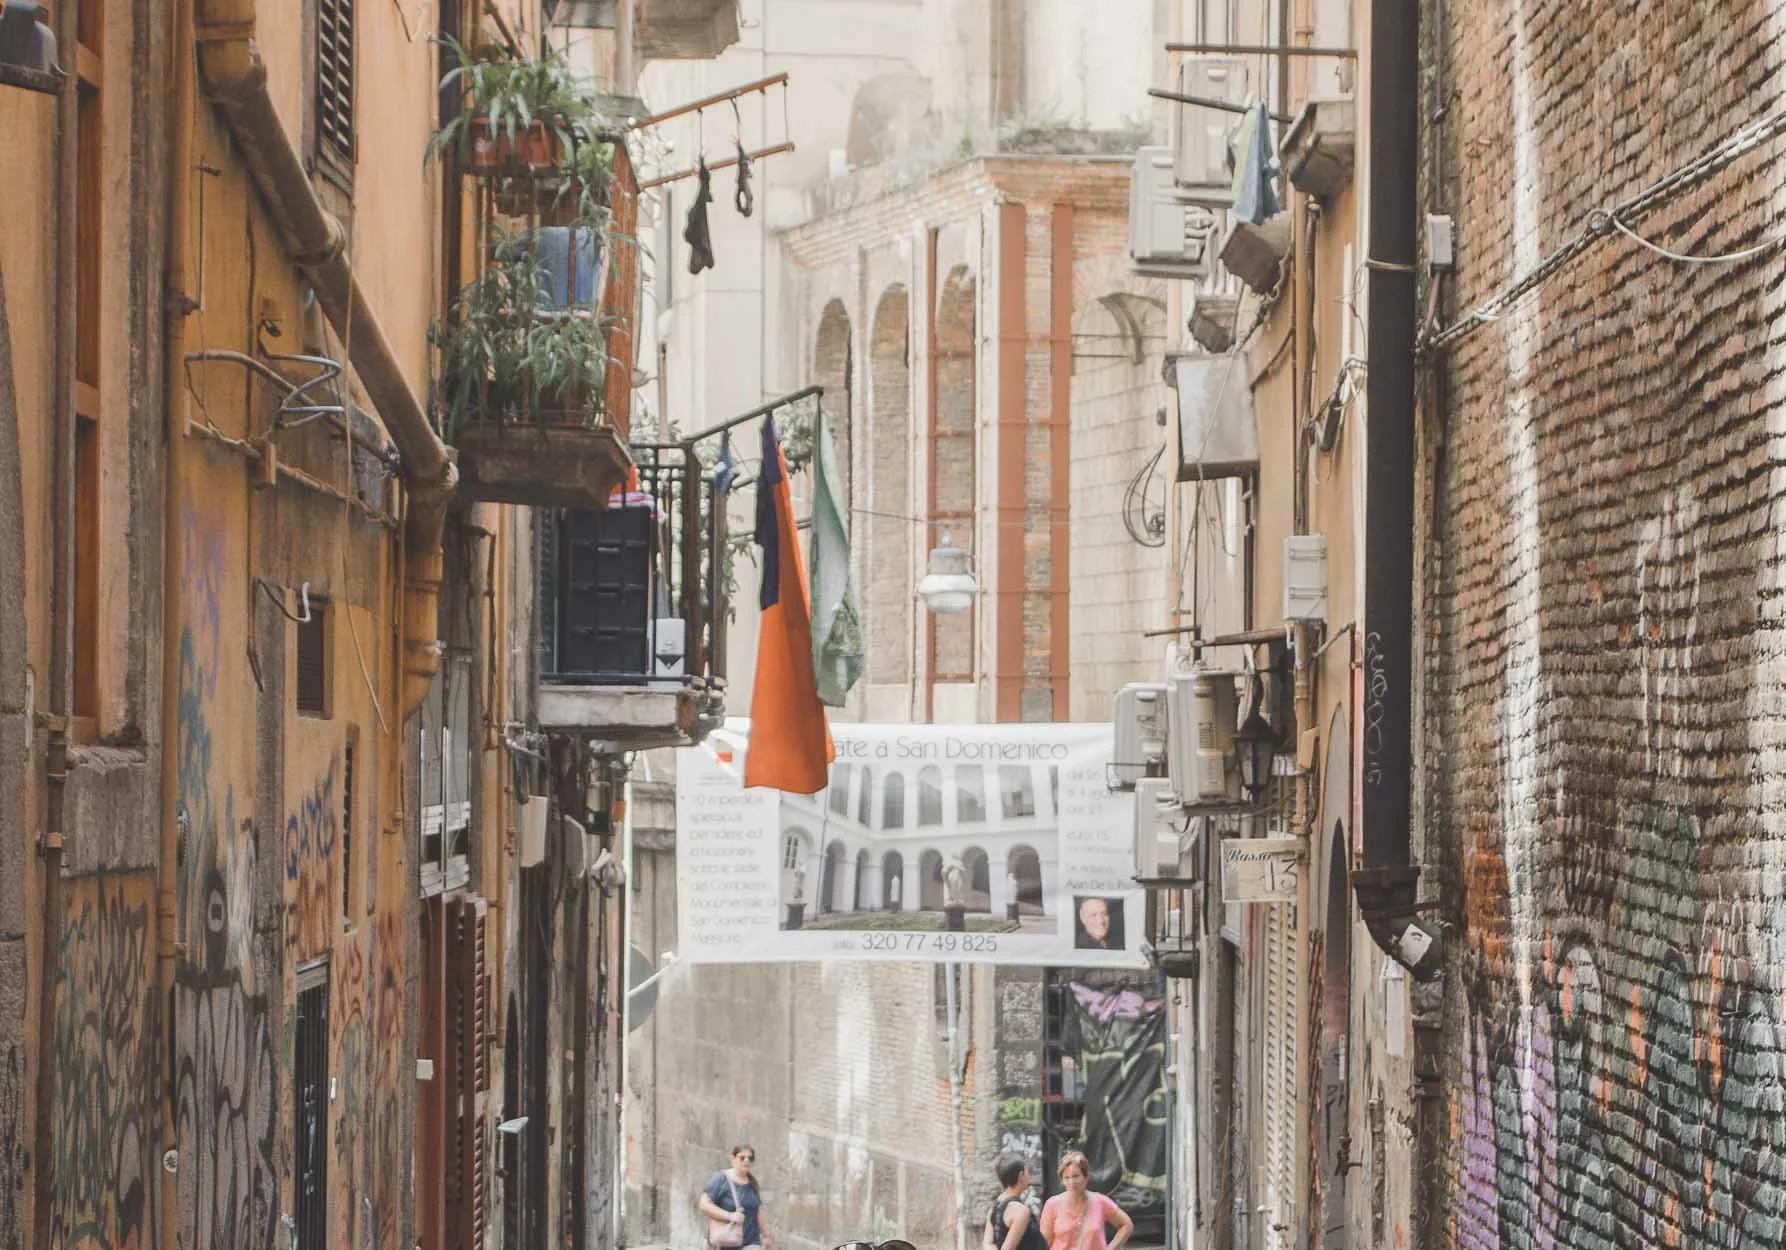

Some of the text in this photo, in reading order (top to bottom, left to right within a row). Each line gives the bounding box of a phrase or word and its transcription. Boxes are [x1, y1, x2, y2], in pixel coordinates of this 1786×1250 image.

[875, 740, 888, 759] a
[895, 735, 938, 759] San
[945, 737, 1069, 761] Domenico
[861, 932, 898, 951] 320
[904, 933, 927, 951] 77
[932, 934, 957, 952] 49
[961, 934, 998, 953] 825
